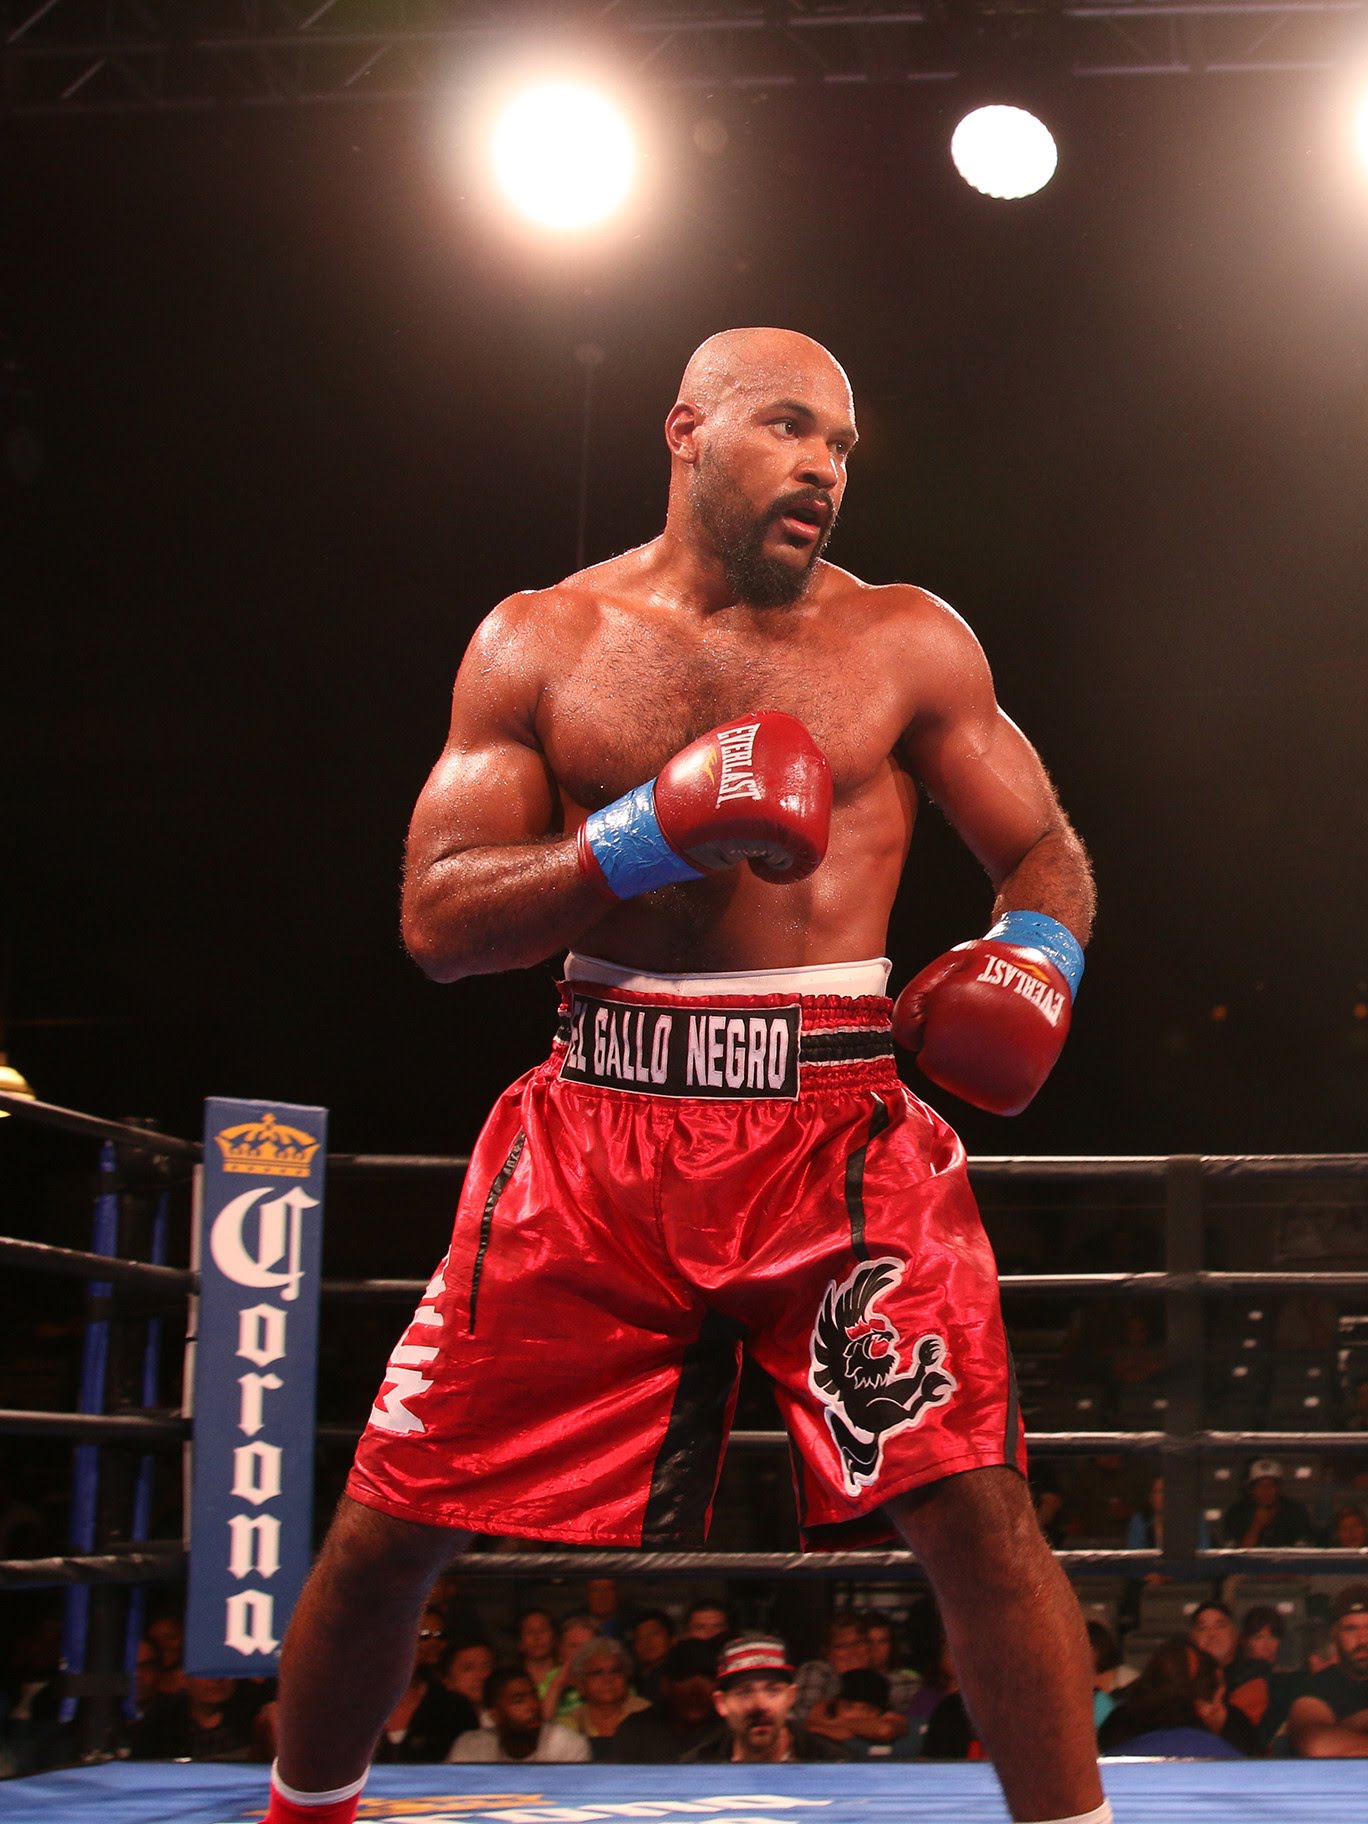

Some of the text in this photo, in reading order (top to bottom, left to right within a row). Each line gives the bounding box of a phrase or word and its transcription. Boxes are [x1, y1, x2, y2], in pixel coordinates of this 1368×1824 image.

[715, 723, 762, 809] EVERLAST
[976, 954, 1066, 1028] EVERLAST
[593, 1007, 673, 1085] GALLO
[686, 1015, 789, 1091] NEGRO
[210, 1187, 320, 1656] Corona
